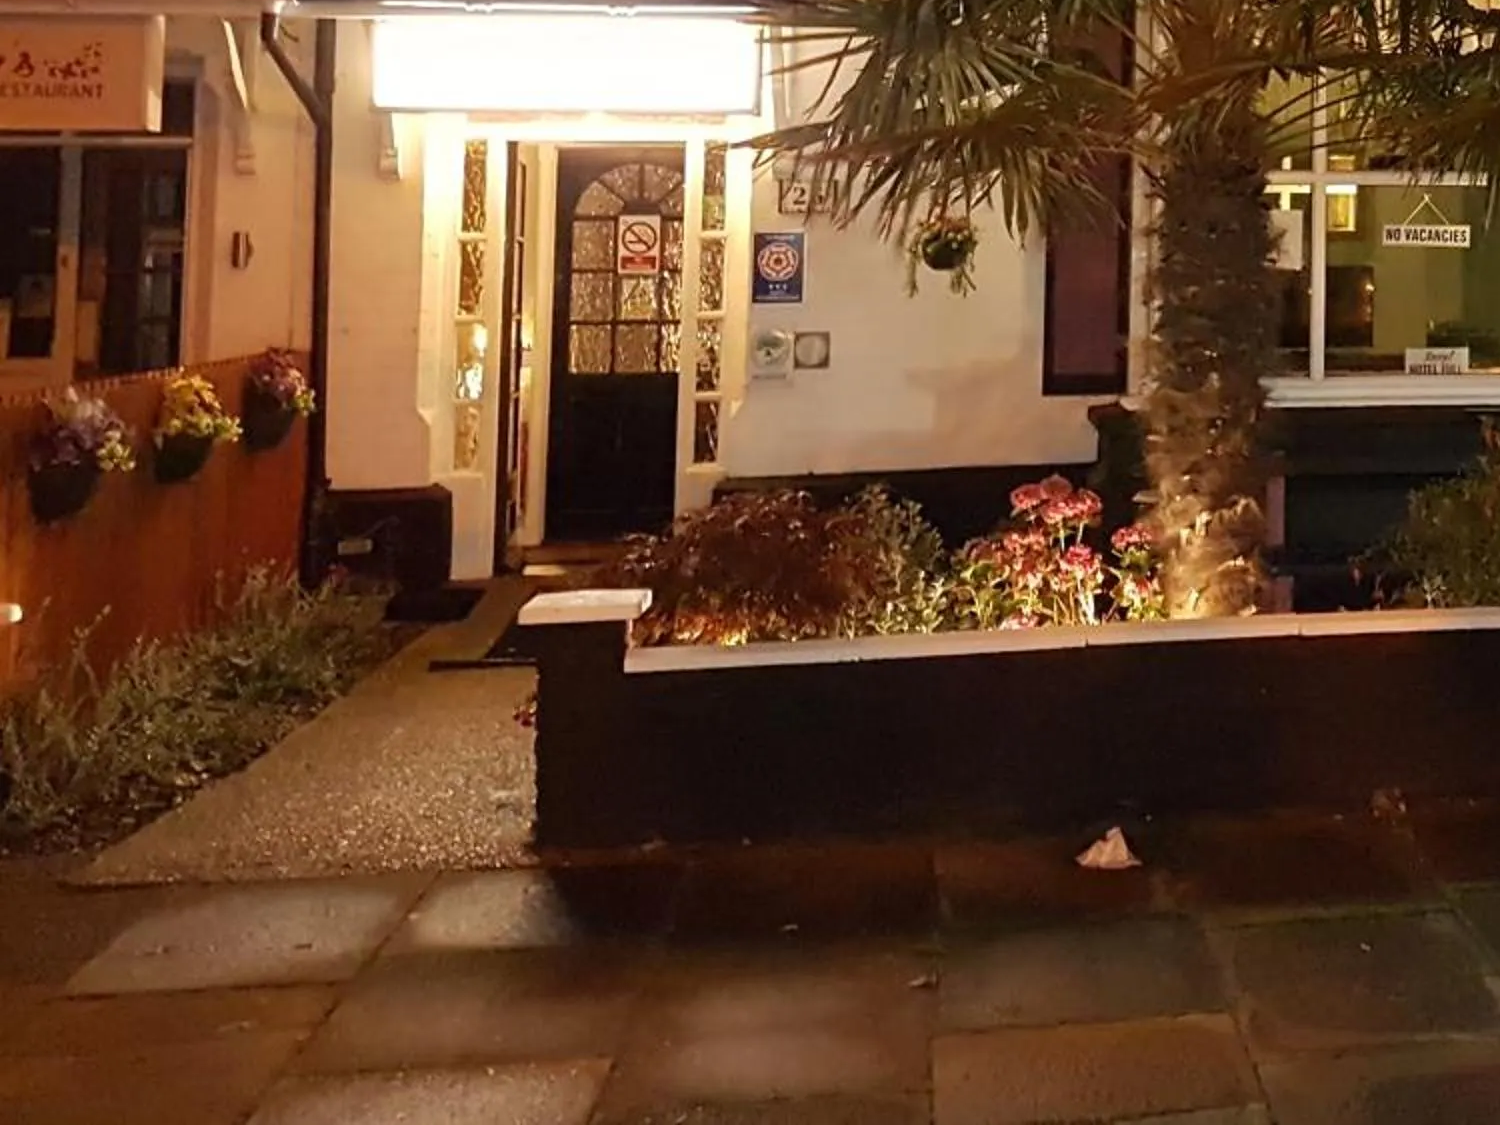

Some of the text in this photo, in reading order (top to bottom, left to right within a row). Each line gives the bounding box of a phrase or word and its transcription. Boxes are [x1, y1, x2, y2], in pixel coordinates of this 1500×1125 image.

[0, 82, 103, 99] ESTAURANT
[1385, 228, 1467, 244] NO VACANCIES
